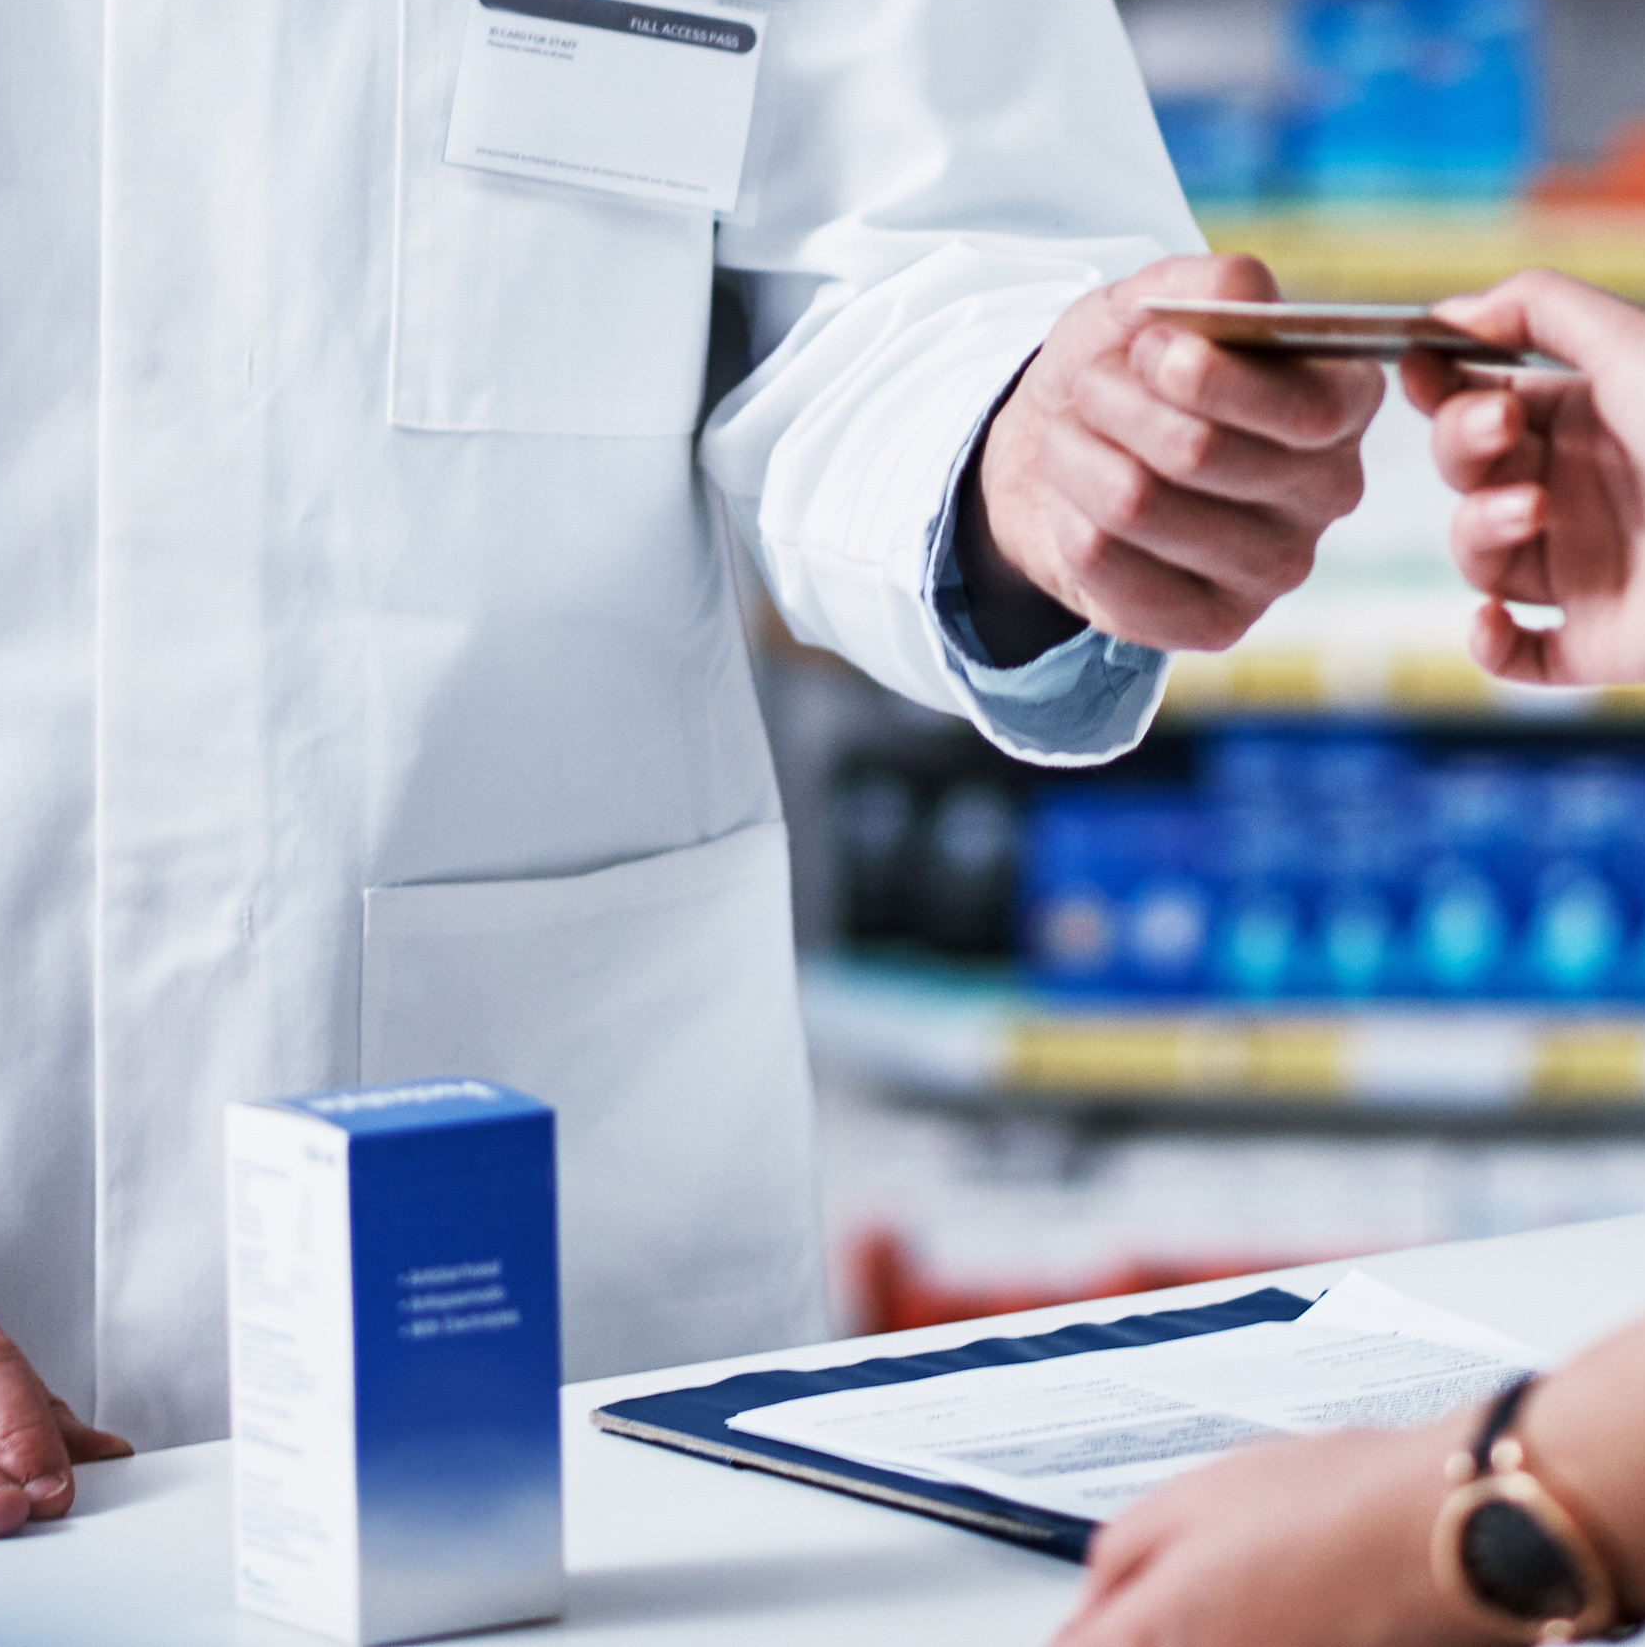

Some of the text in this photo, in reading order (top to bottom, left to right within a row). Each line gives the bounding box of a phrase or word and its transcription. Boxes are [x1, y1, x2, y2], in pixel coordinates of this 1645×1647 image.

[630, 16, 739, 49] FULL ACCESS PASS
